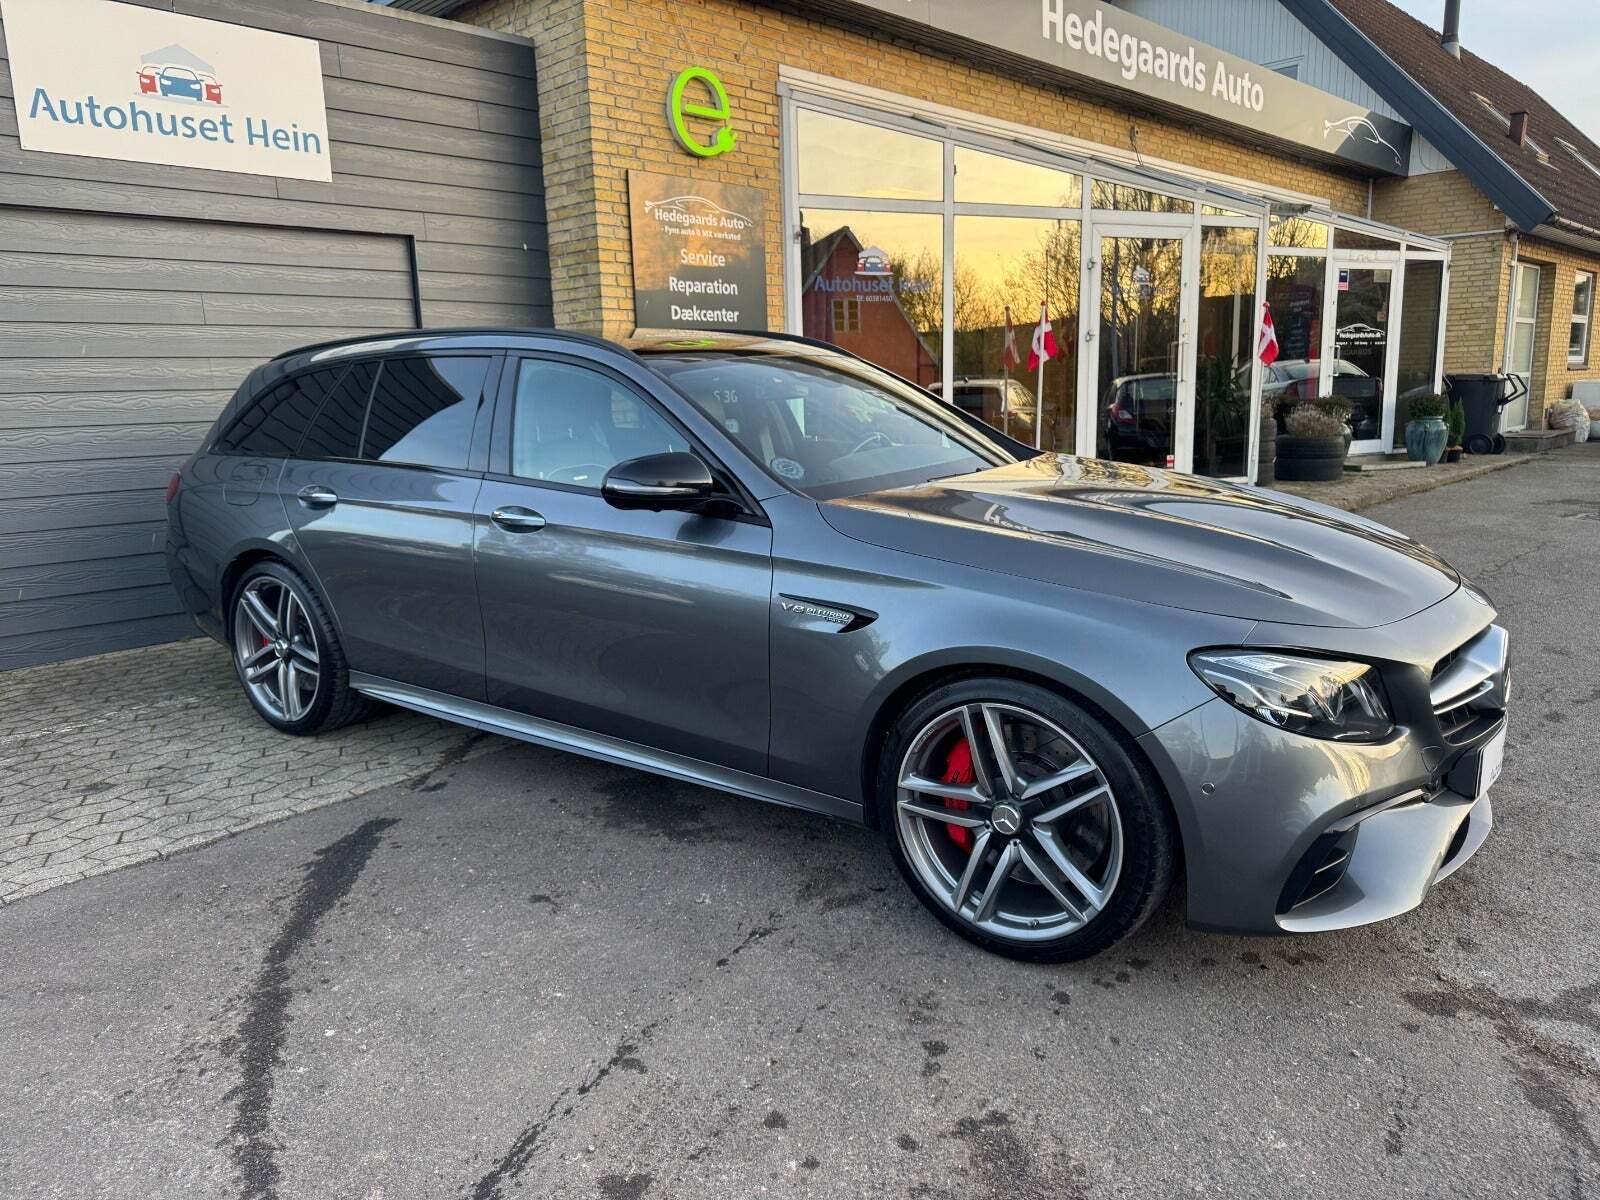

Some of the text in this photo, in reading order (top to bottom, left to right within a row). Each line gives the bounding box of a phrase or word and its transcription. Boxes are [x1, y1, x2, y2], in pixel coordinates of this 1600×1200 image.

[1042, 0, 1264, 112] Hedegaards Auto
[29, 87, 321, 154] Autohuset Hein
[655, 208, 744, 230] Hedegaards Auto
[680, 248, 725, 267] Service
[669, 276, 738, 296] Reparation
[814, 275, 894, 293] Autohuset
[671, 305, 739, 322] Dækcenter
[781, 602, 804, 614] V8
